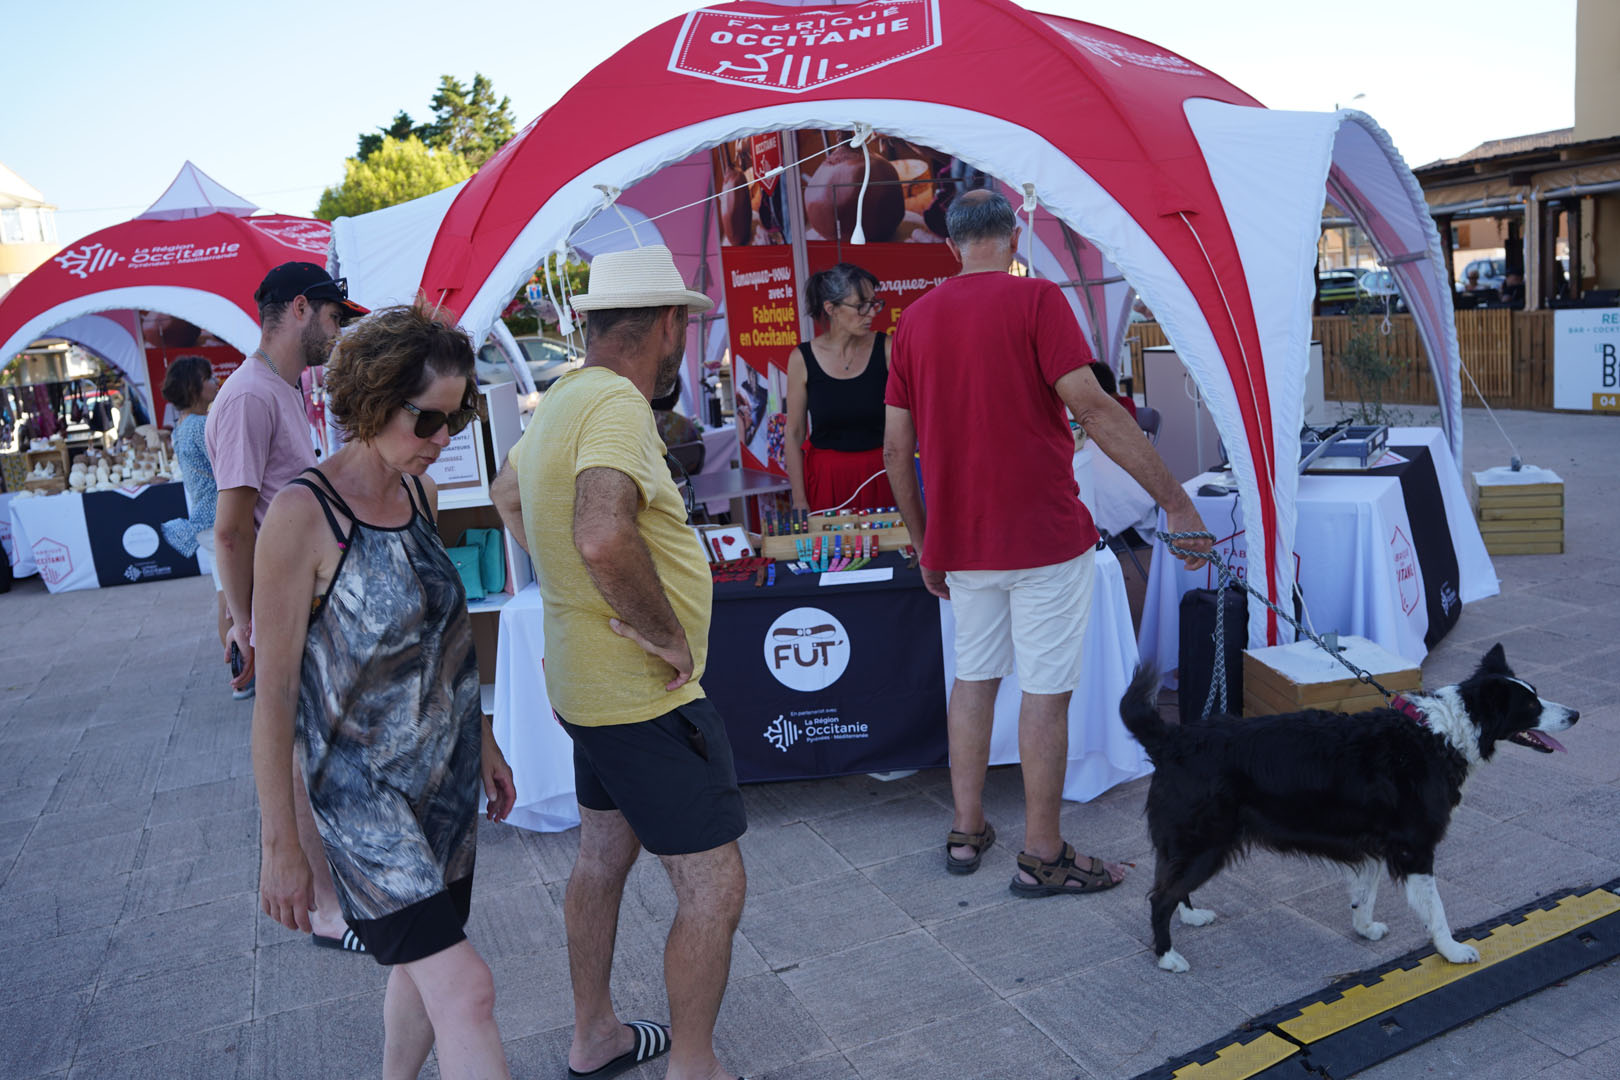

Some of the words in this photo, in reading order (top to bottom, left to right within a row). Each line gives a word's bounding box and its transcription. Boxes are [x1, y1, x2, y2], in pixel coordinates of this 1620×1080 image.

[710, 18, 909, 47] OCCITANIE
[131, 242, 240, 263] Occitanie
[752, 302, 795, 327] Fabriqué
[1602, 313, 1620, 324] RE
[740, 333, 752, 346] en
[752, 324, 797, 346] Occitanie
[1600, 396, 1617, 407] 04
[805, 721, 868, 737] Occitanie
[813, 716, 839, 725] Région
